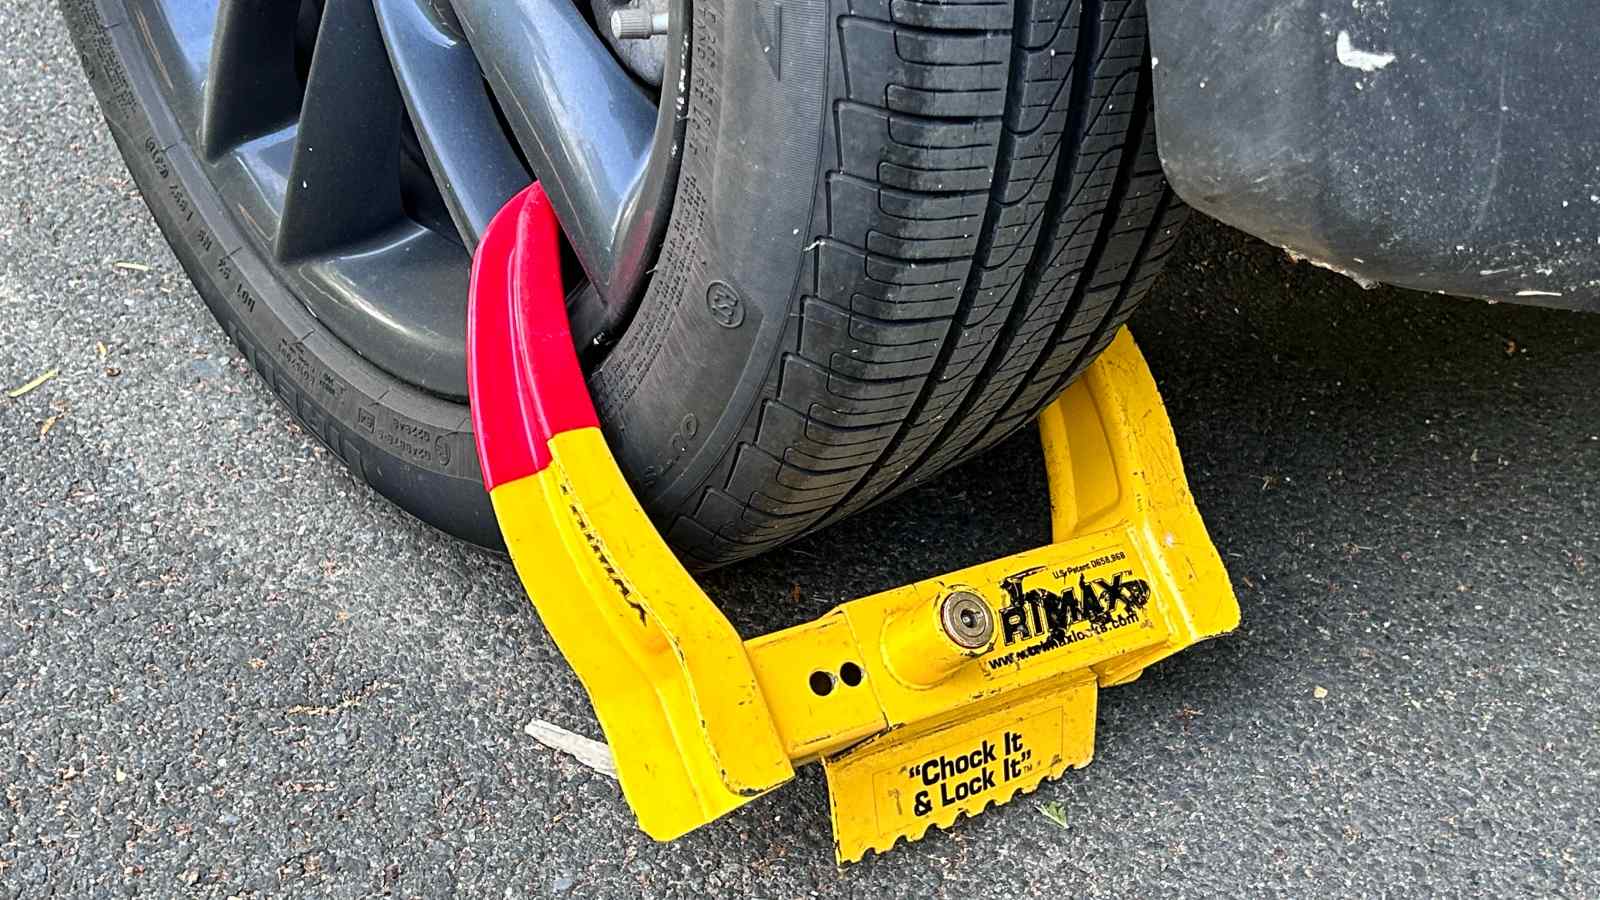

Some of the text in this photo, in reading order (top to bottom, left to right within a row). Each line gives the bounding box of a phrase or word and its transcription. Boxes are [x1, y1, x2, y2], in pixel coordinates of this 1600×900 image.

[1004, 731, 1024, 756] It
[914, 790, 933, 817] &
[940, 767, 996, 808] Lock
